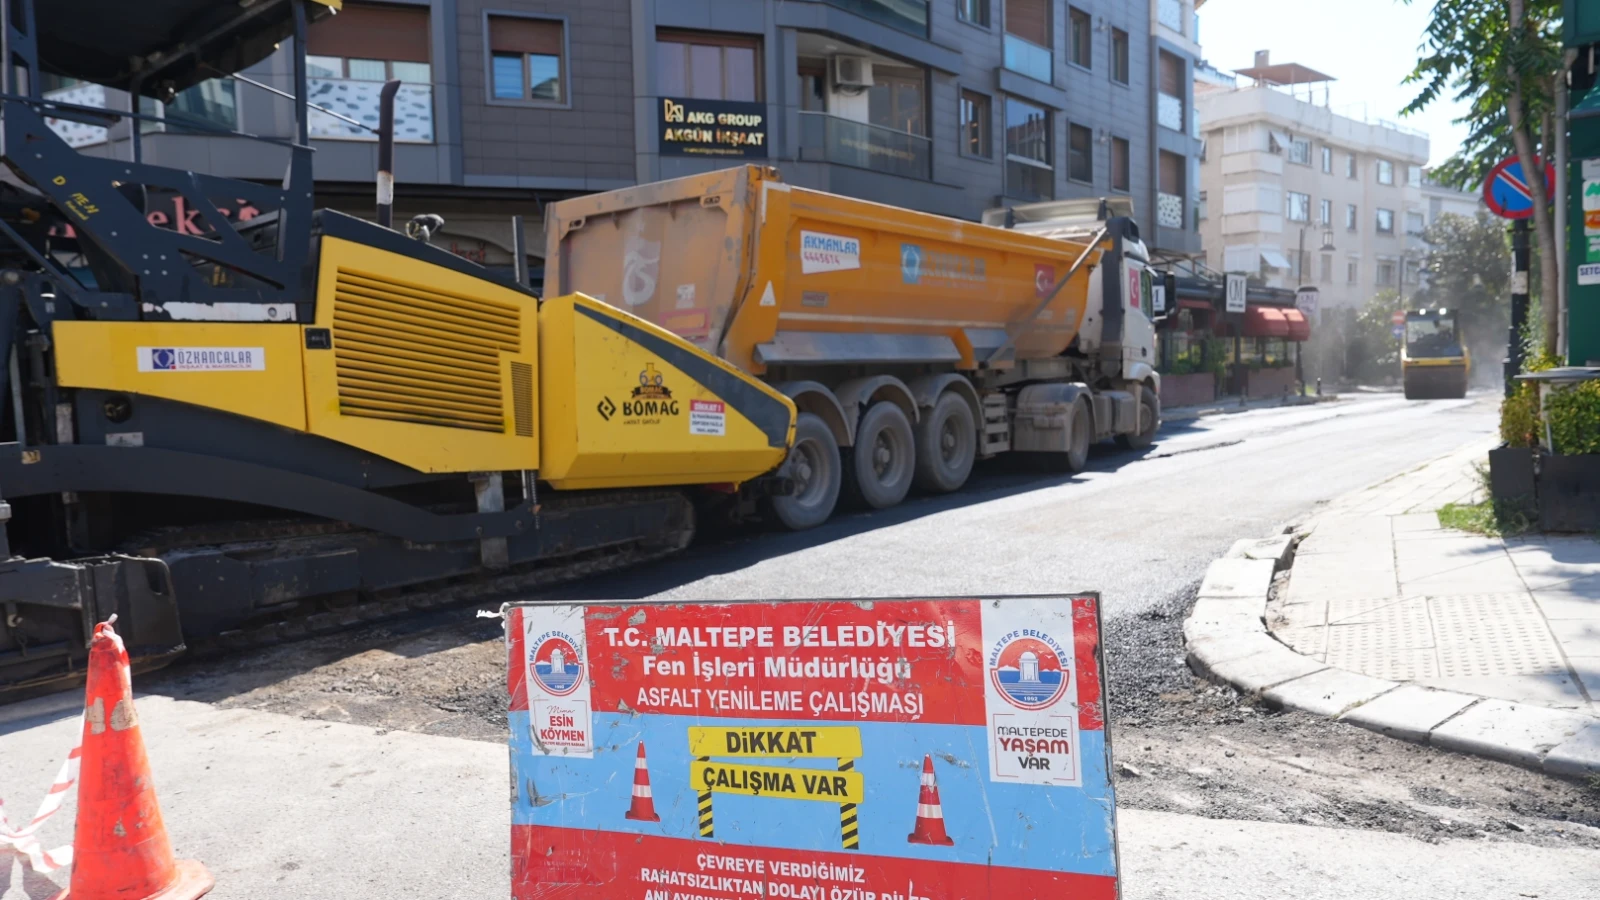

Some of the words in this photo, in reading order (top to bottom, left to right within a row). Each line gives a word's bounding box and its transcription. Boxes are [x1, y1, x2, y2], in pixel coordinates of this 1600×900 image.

[687, 111, 715, 124] AKG
[717, 113, 762, 127] GROUP
[664, 127, 713, 143] AKGÜN
[716, 128, 764, 146] İNŞAAT
[803, 235, 858, 256] AKMANLAR
[178, 348, 252, 364] ÖZKANCALAR
[622, 400, 679, 416] BOMAG
[603, 627, 648, 647] T.C.
[655, 626, 774, 647] MALTEPE
[783, 620, 956, 647] BELEDİYESİ
[529, 631, 551, 661] MALTEPE
[989, 630, 1020, 666] MALTEPE
[1022, 629, 1070, 668] BELEDİYESİ
[643, 655, 686, 676] Fen
[693, 651, 755, 682] İşleri
[764, 656, 912, 684] Müdürlüğü
[637, 687, 702, 708] ASFALT
[706, 685, 804, 711] YENİLEME
[809, 690, 924, 718] ÇALIŞMASI
[549, 713, 574, 727] ESİN
[540, 727, 585, 742] KÖYMEN
[997, 726, 1068, 738] MALTEPEDE
[999, 738, 1070, 757] YAŞAM
[1018, 756, 1051, 770] VAR
[703, 767, 796, 795] ÇALIŞMA
[802, 774, 848, 797] VAR
[696, 853, 765, 873] ÇEVREYE
[768, 860, 866, 883] VERDİĞİMİZ
[641, 867, 763, 895] RAHATSIZLIKTAN
[768, 881, 825, 900] DOLAYI
